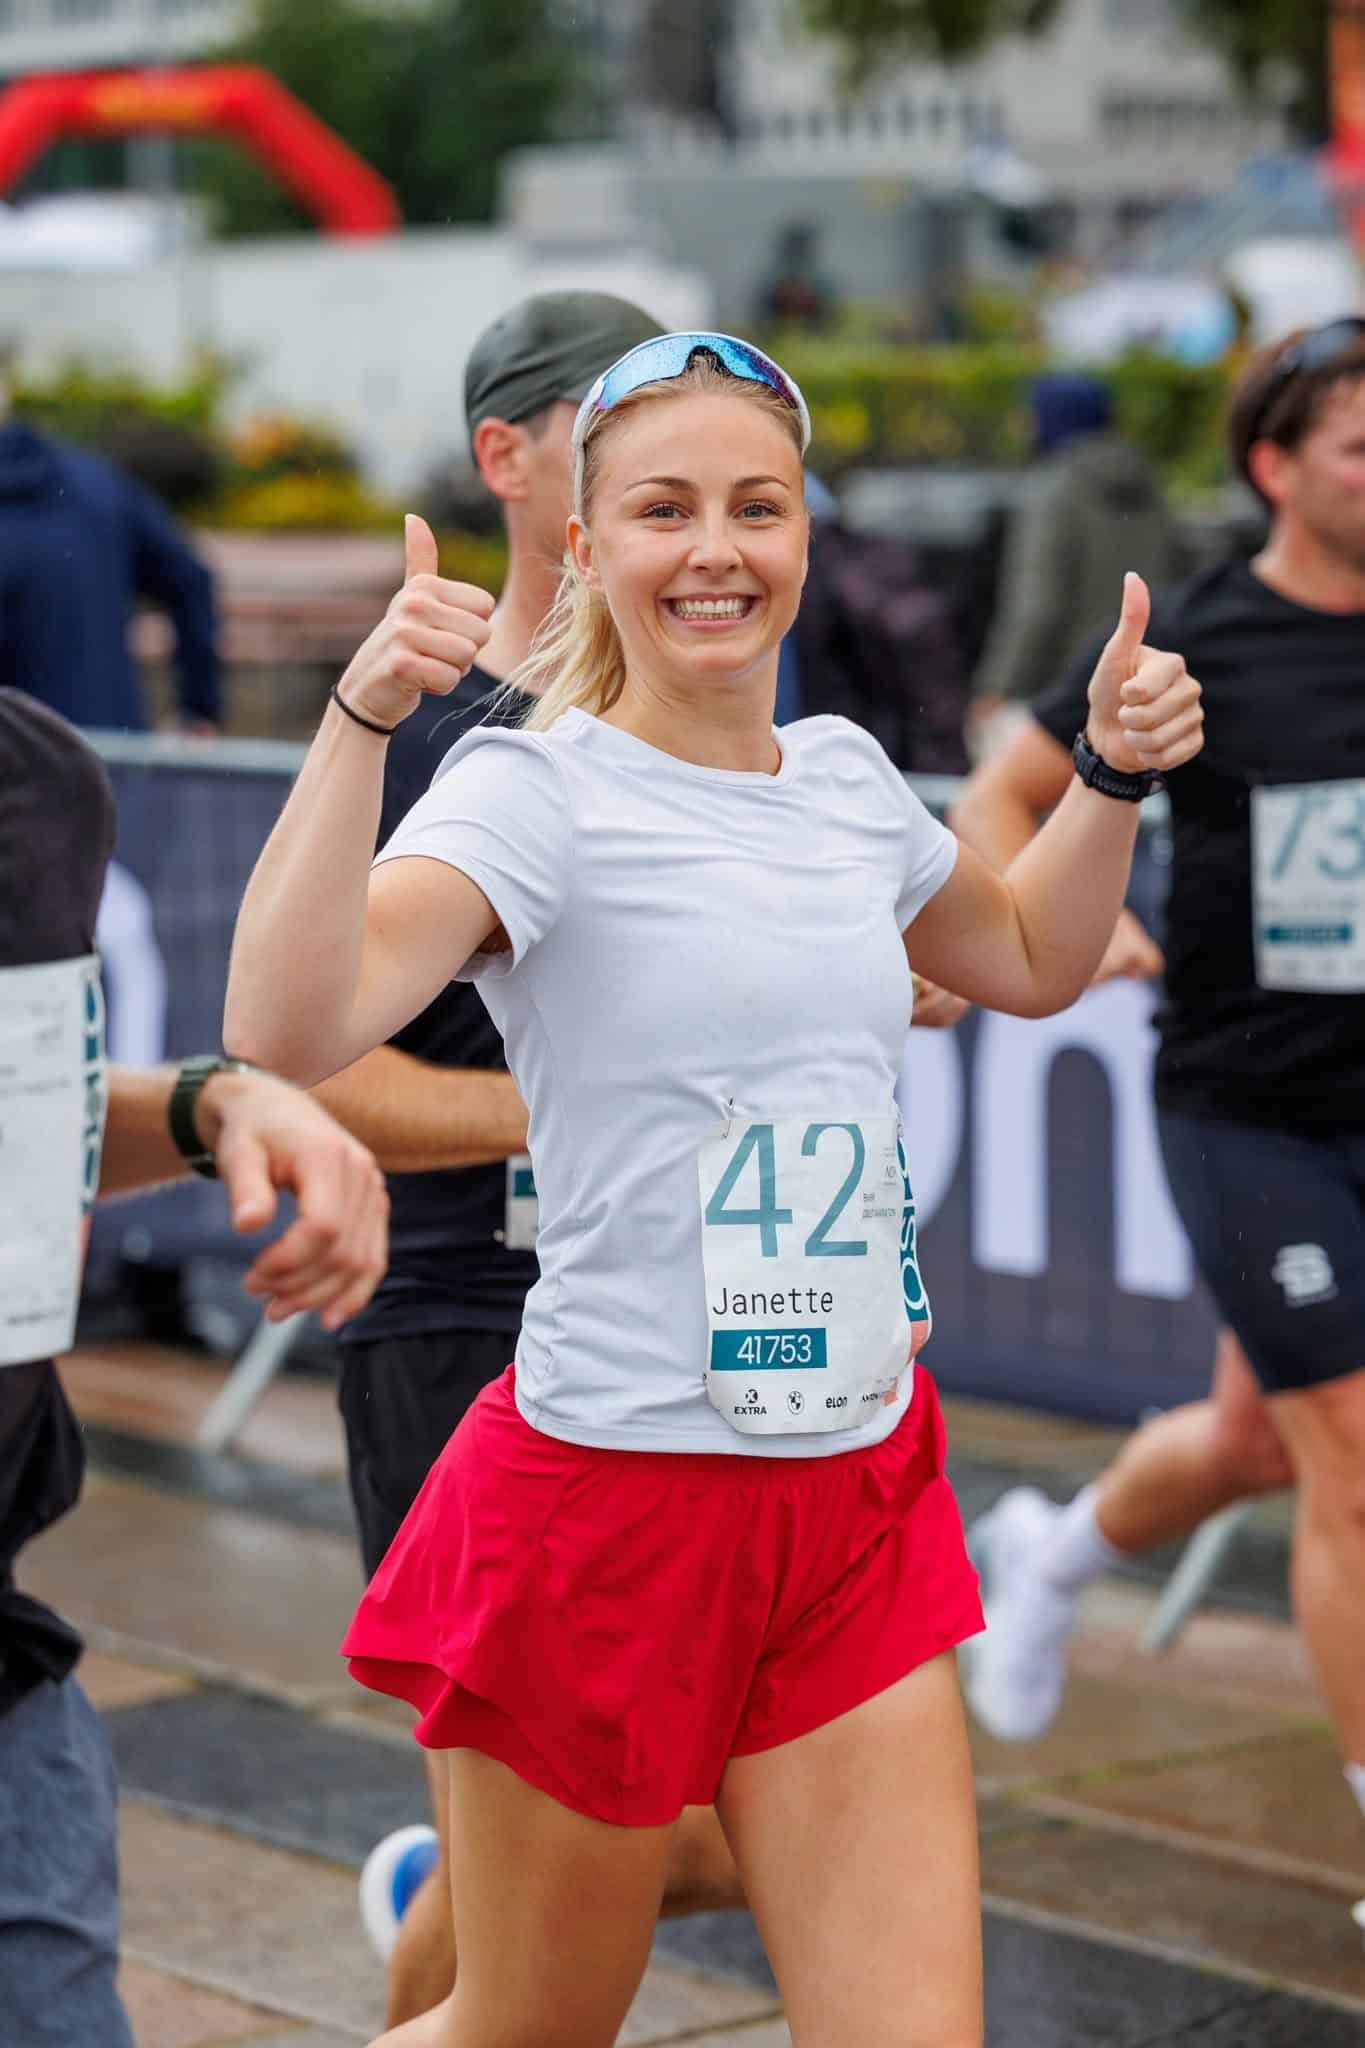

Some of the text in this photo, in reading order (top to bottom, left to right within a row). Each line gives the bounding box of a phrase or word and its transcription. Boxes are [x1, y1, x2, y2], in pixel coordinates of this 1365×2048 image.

[705, 1123, 867, 1257] 42
[713, 1287, 833, 1315] Janette
[736, 1334, 812, 1364] 41753
[734, 1405, 768, 1416] EXTRA
